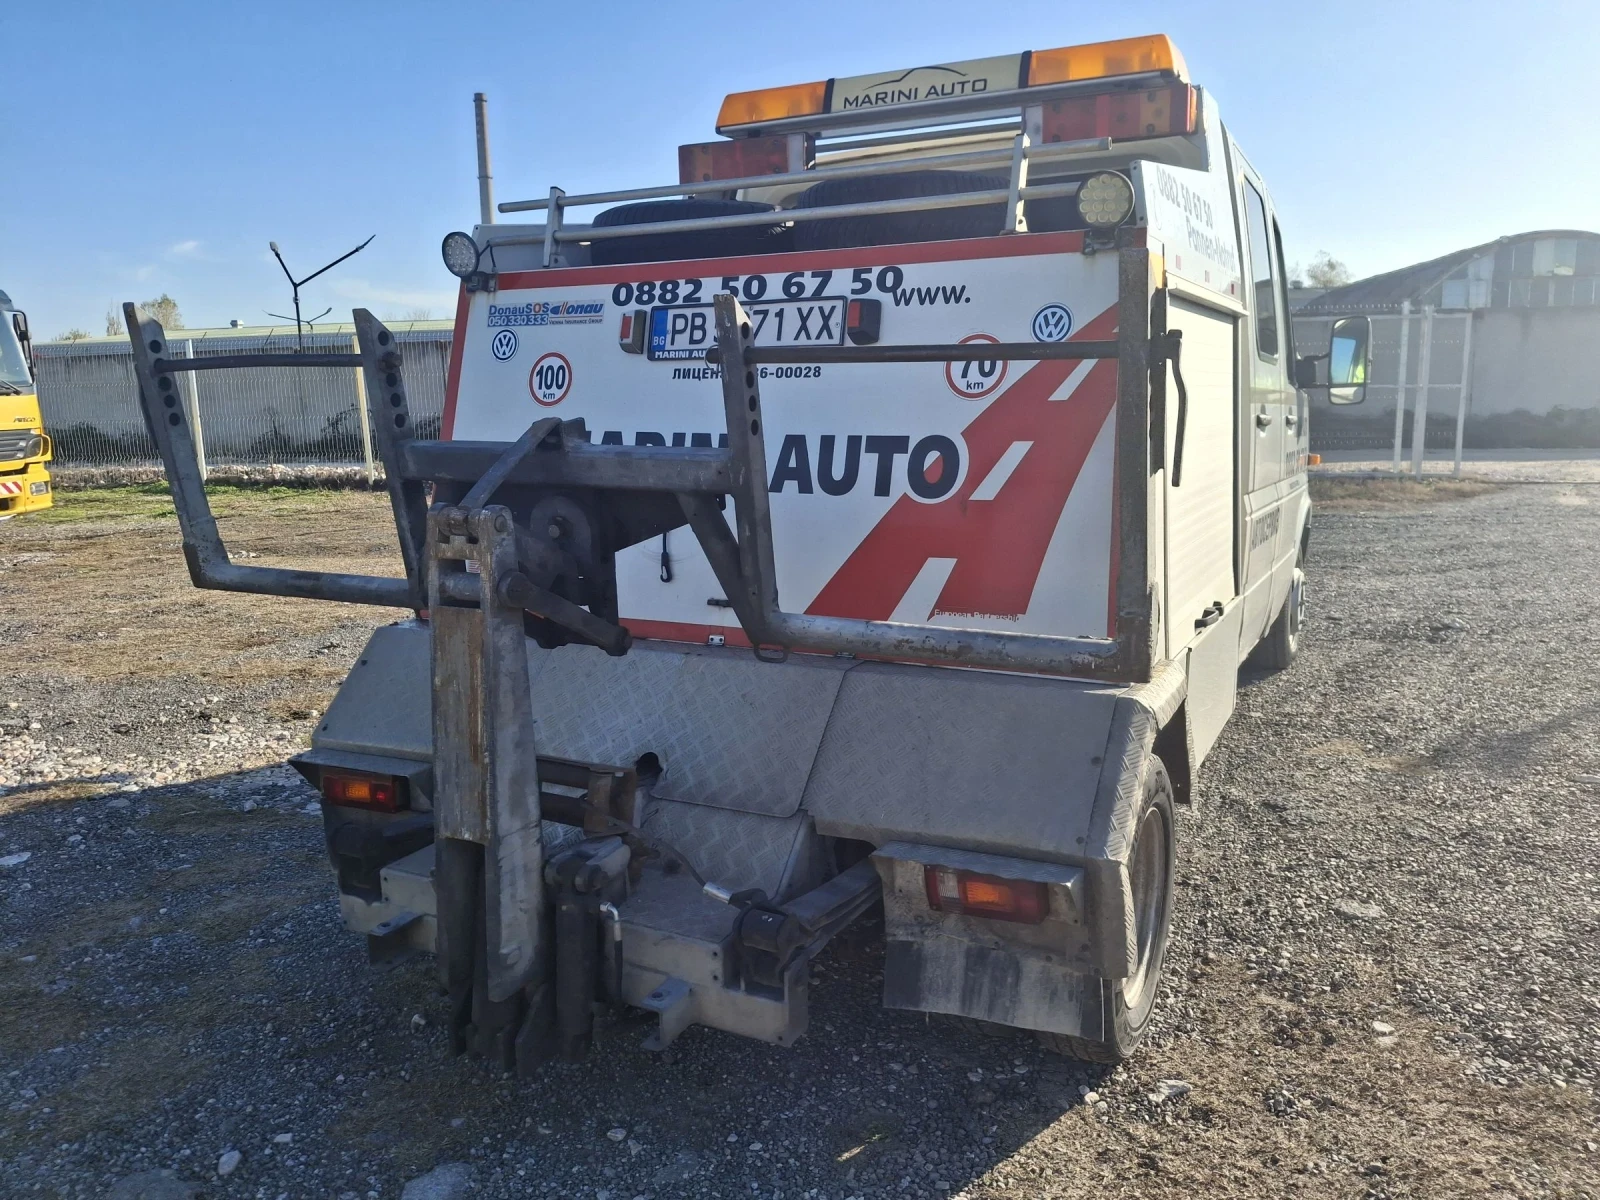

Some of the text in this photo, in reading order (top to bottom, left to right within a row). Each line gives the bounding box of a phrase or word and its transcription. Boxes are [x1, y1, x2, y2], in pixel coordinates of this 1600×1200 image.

[843, 78, 988, 109] MARINI AUTO
[1156, 164, 1181, 209] 0882
[612, 265, 904, 307] 0882 50 67 50
[892, 284, 971, 307] www.
[488, 302, 550, 316] DonauSOS
[487, 314, 549, 327] 050330333
[670, 311, 707, 346] PB
[793, 304, 837, 341] XX
[653, 335, 666, 346] BG
[654, 350, 690, 359] MARINI
[535, 364, 567, 391] 100
[672, 365, 822, 381] ЛИЦЕН 6-00028
[966, 380, 984, 390] km
[542, 391, 556, 400] km
[768, 434, 961, 500] AUTO
